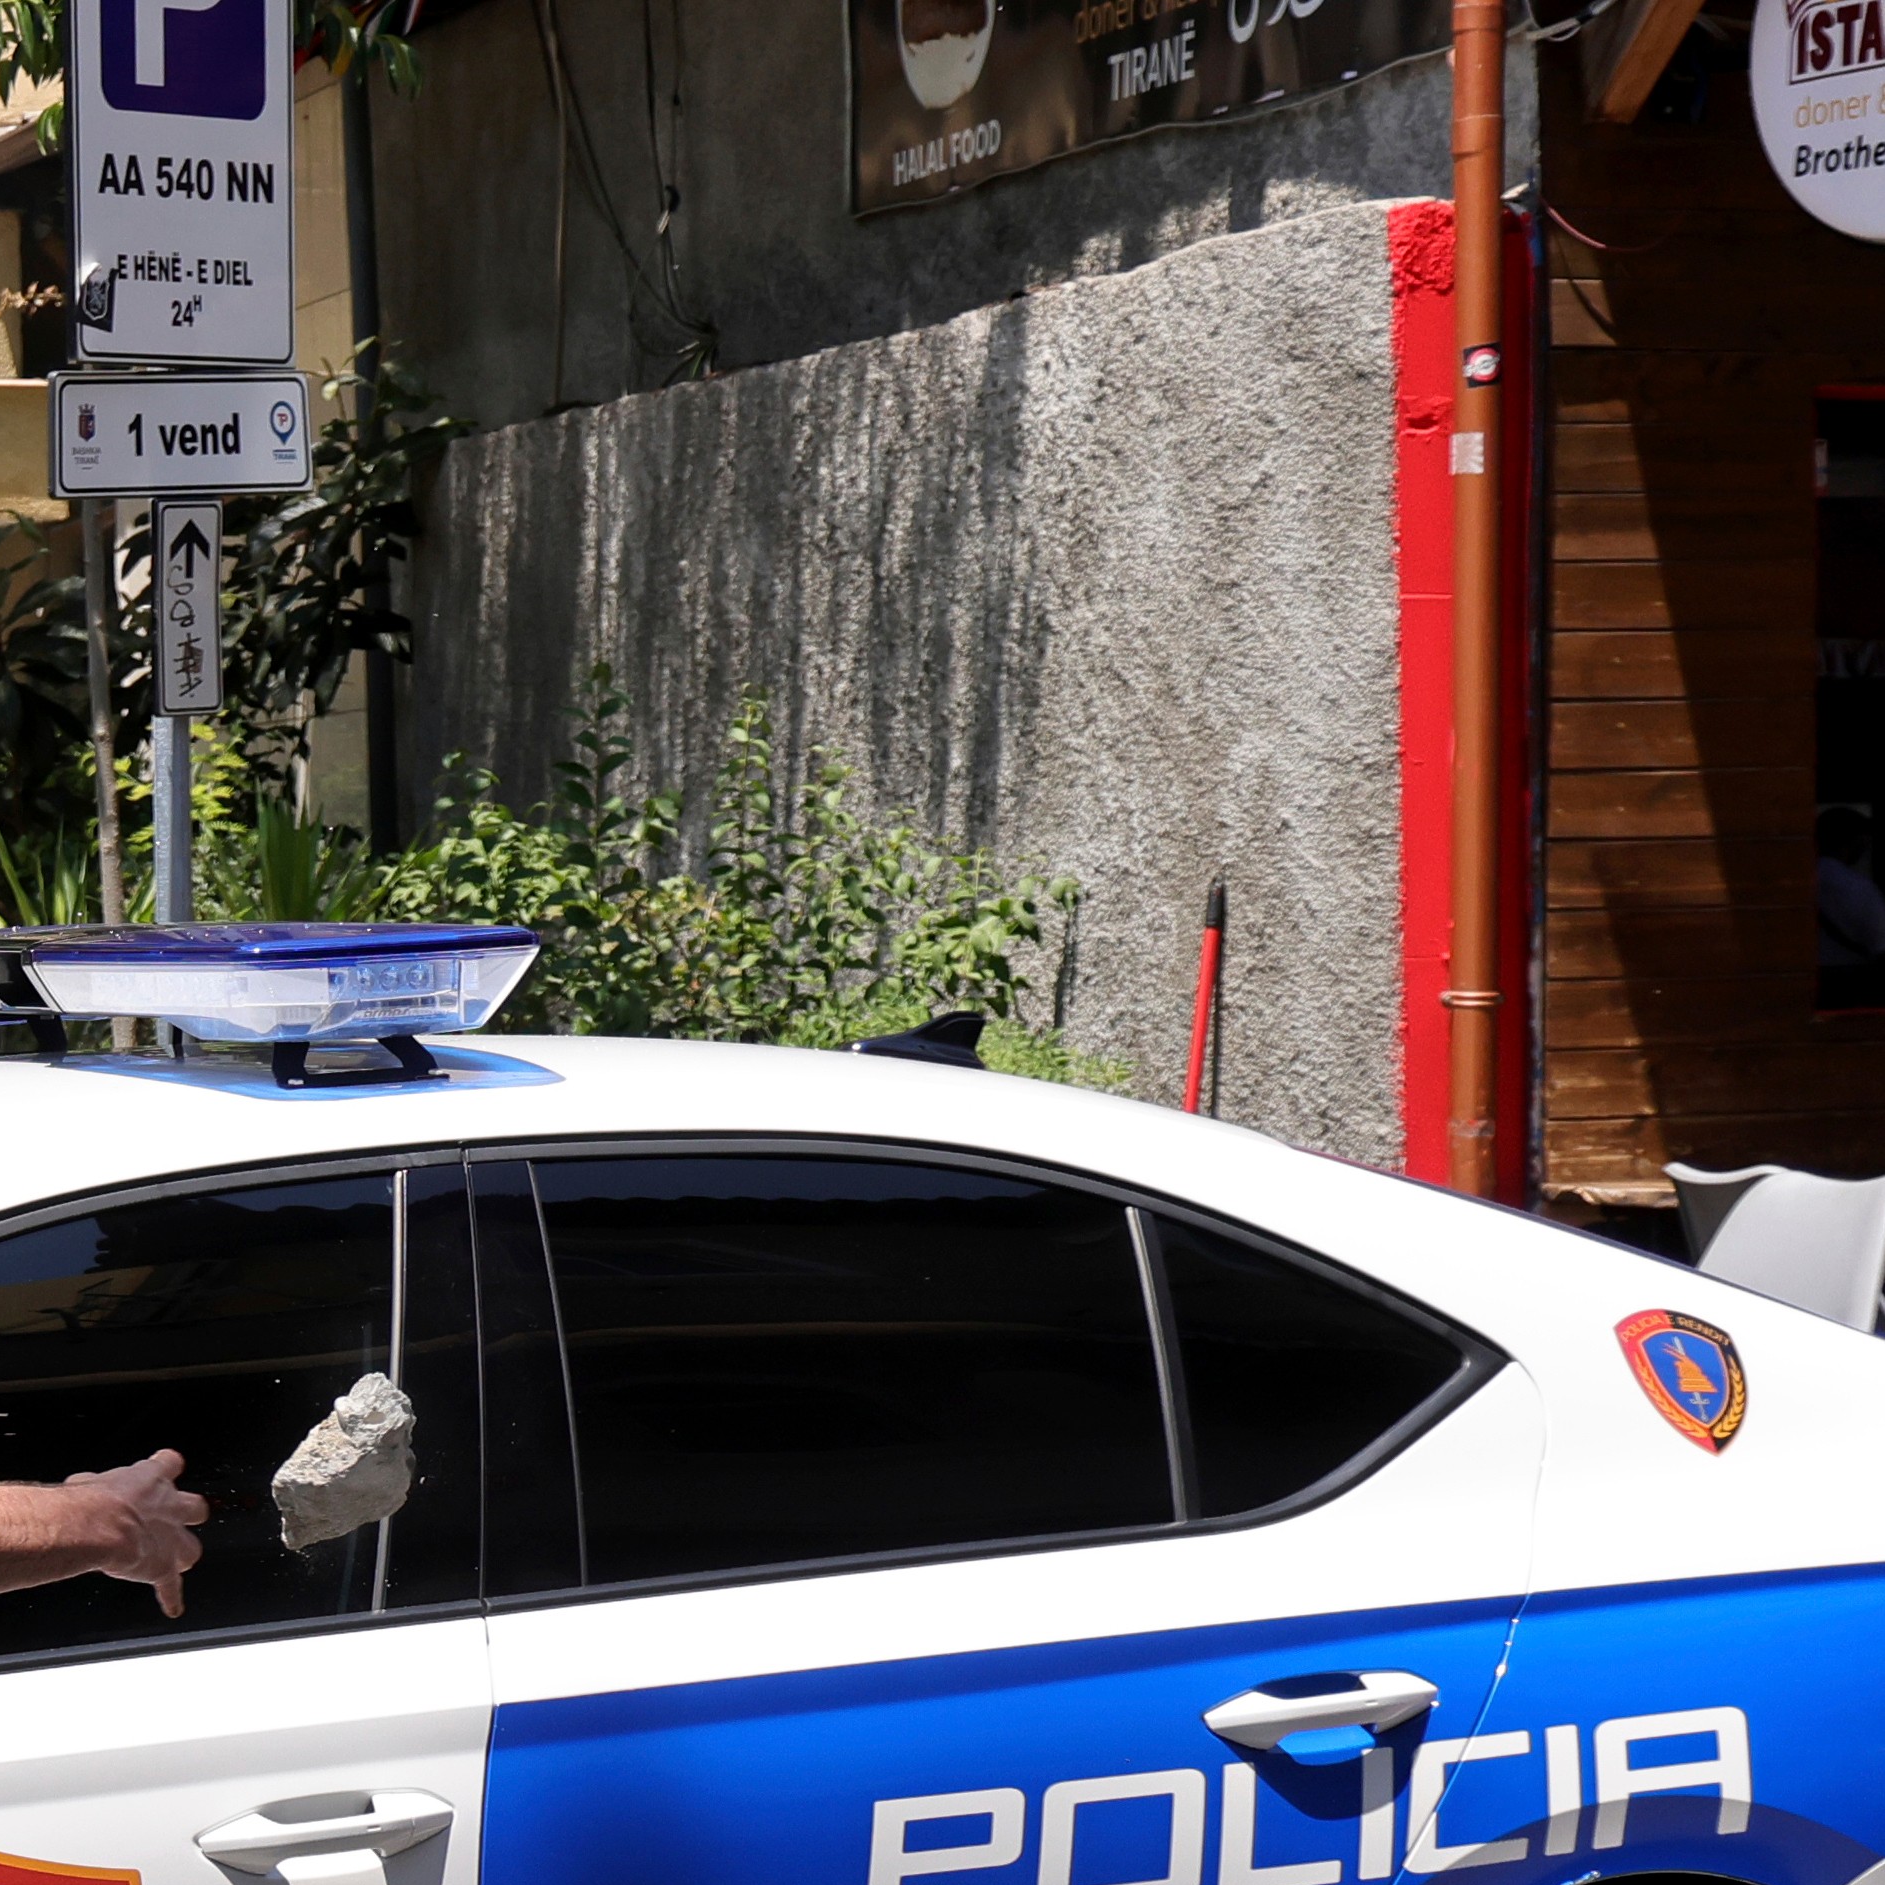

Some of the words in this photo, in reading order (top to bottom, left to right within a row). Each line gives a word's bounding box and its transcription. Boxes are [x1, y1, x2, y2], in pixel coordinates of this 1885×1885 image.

[1107, 19, 1196, 101] TIRANË
[1794, 94, 1871, 128] doner
[892, 140, 946, 187] HALAL
[949, 118, 1002, 168] FOOD
[99, 153, 144, 196] AA
[156, 157, 214, 201] 540
[227, 161, 275, 204] NN
[117, 253, 128, 280] E
[134, 250, 182, 284] HËNË
[197, 258, 208, 285] E
[214, 258, 253, 287] DIEL
[128, 413, 143, 456] 1
[159, 412, 241, 456] vend
